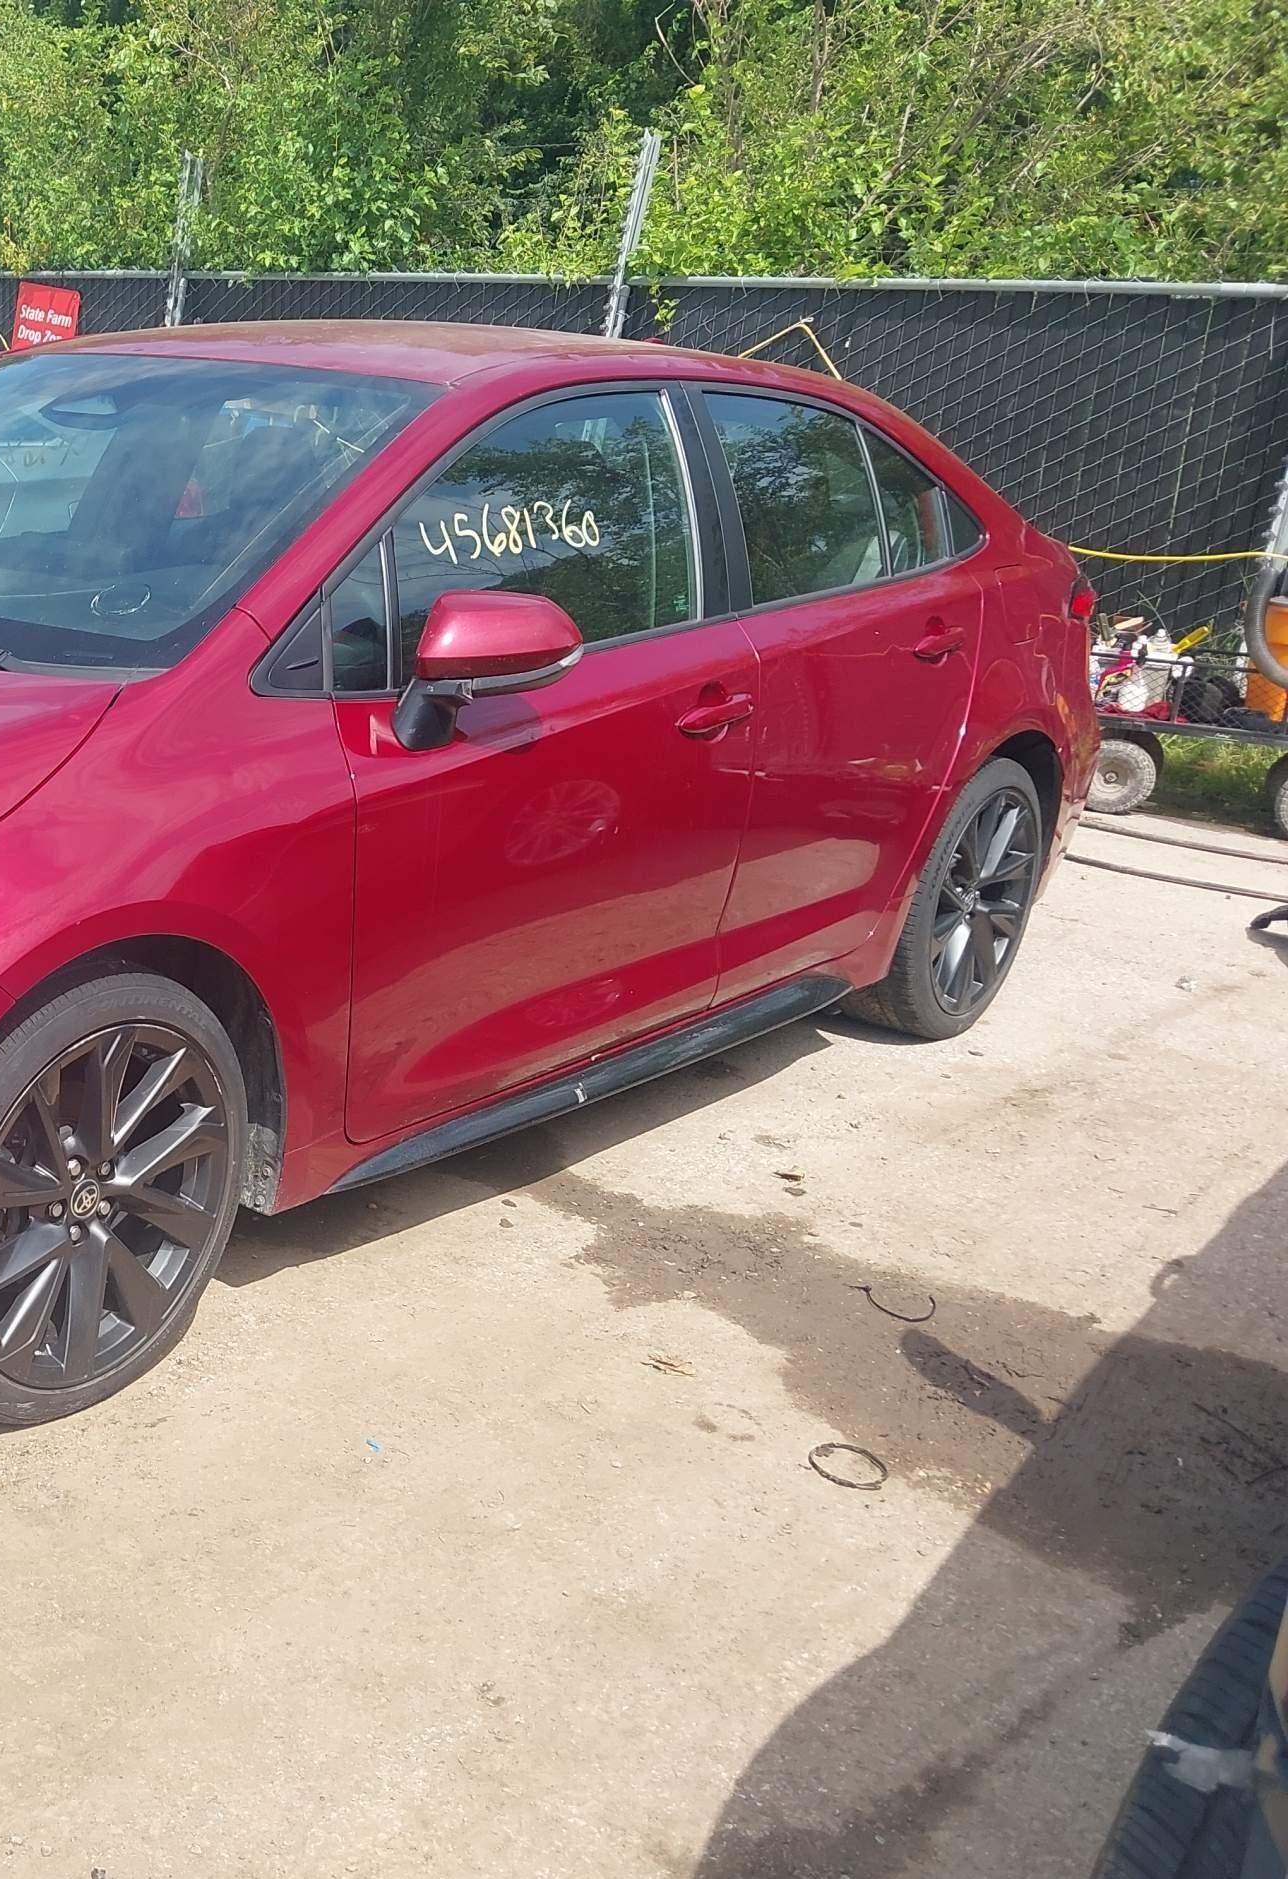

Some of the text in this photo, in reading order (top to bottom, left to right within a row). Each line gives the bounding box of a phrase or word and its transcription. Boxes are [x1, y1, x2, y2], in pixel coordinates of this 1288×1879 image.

[20, 304, 72, 328] State Farm
[18, 325, 63, 344] Drop Zo
[419, 499, 600, 564] 45681360
